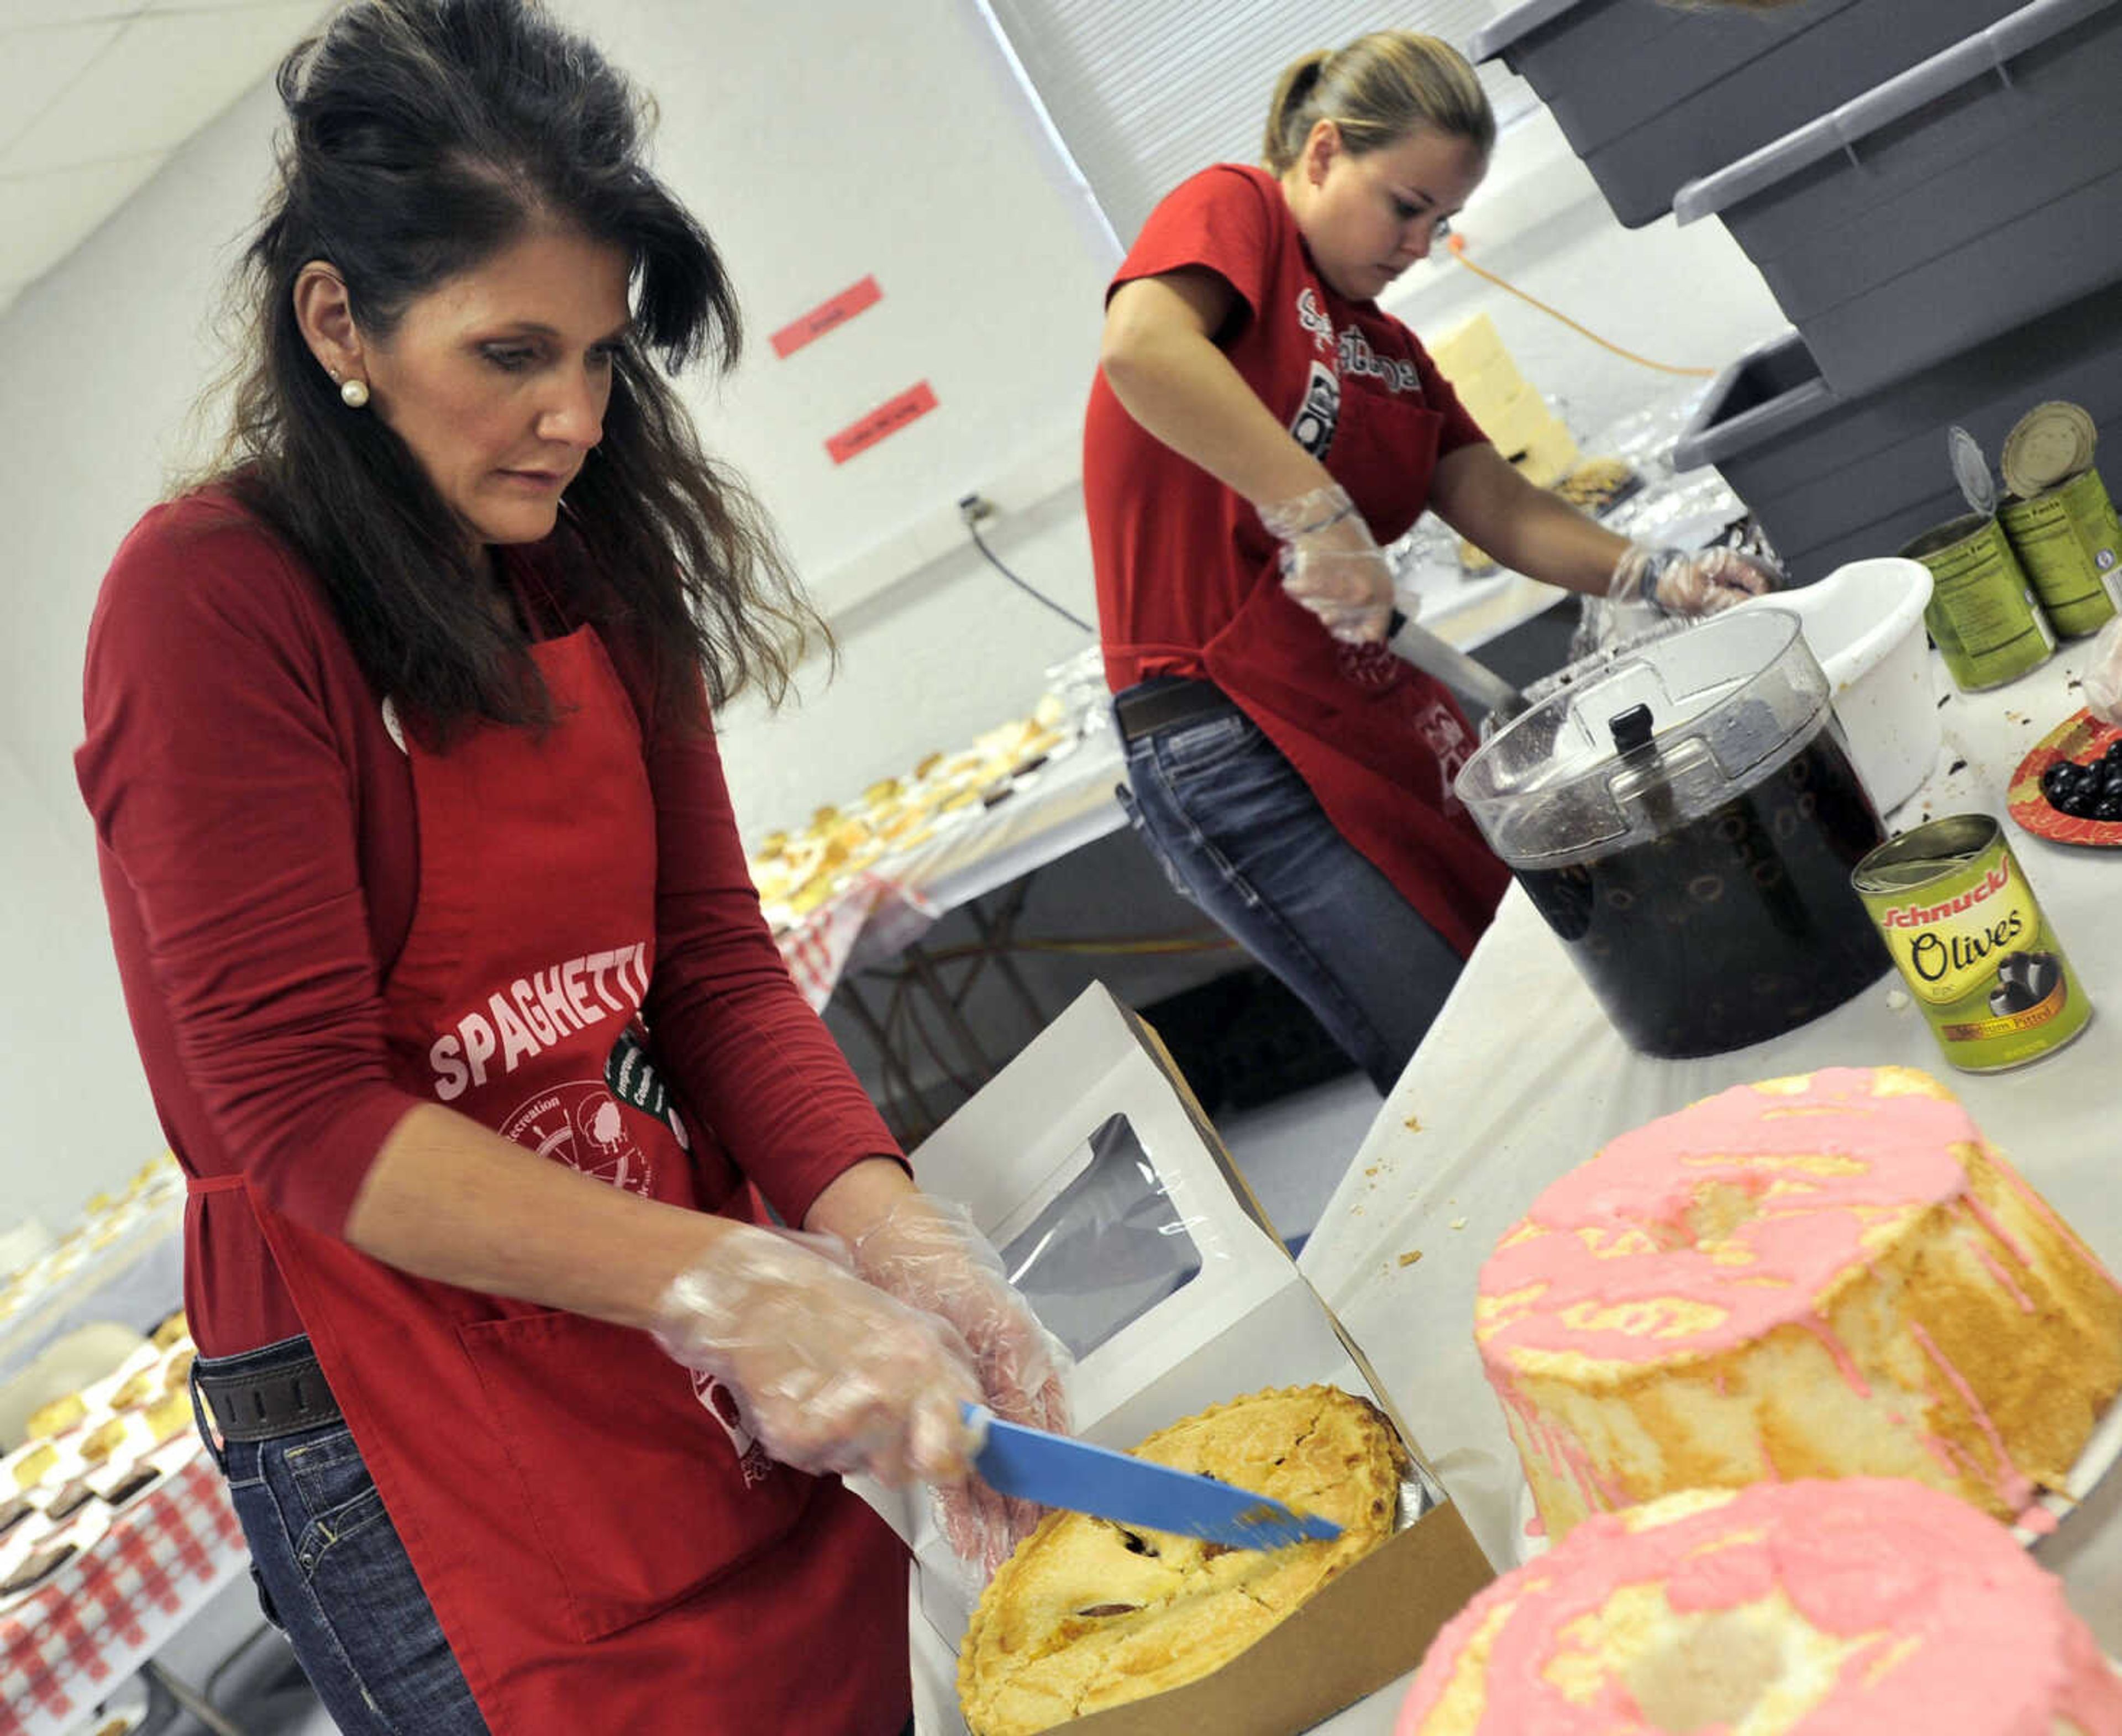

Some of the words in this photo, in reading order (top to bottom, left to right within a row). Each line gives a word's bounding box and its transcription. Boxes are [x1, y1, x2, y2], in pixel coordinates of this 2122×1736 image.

[1910, 909, 2023, 982] Olives
[429, 941, 650, 1100] SPAGHETTI
[507, 1097, 560, 1142] ecreation
